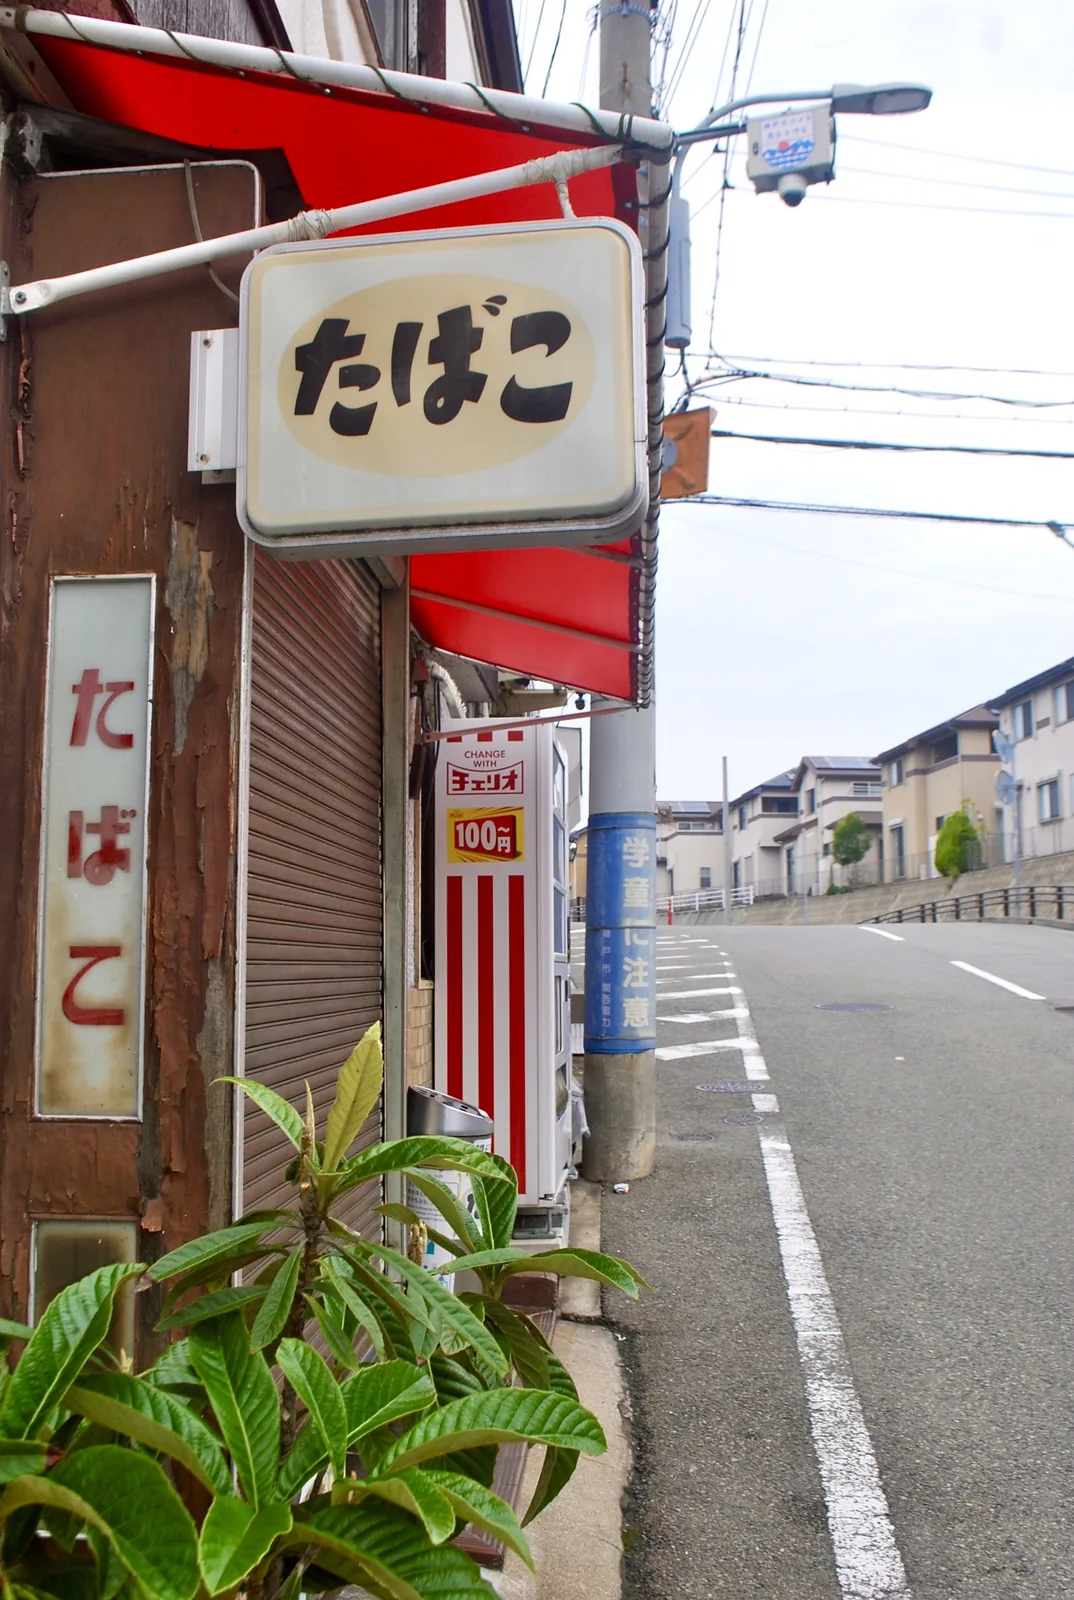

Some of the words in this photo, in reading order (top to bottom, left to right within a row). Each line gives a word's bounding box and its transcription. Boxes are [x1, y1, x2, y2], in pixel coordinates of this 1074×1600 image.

[294, 295, 573, 436] たばこ
[452, 769, 518, 791] チェリオ
[464, 750, 506, 759] CHANGE
[473, 760, 497, 768] WITH
[62, 669, 137, 1026] たばこ
[622, 837, 650, 1028] 学童に注意
